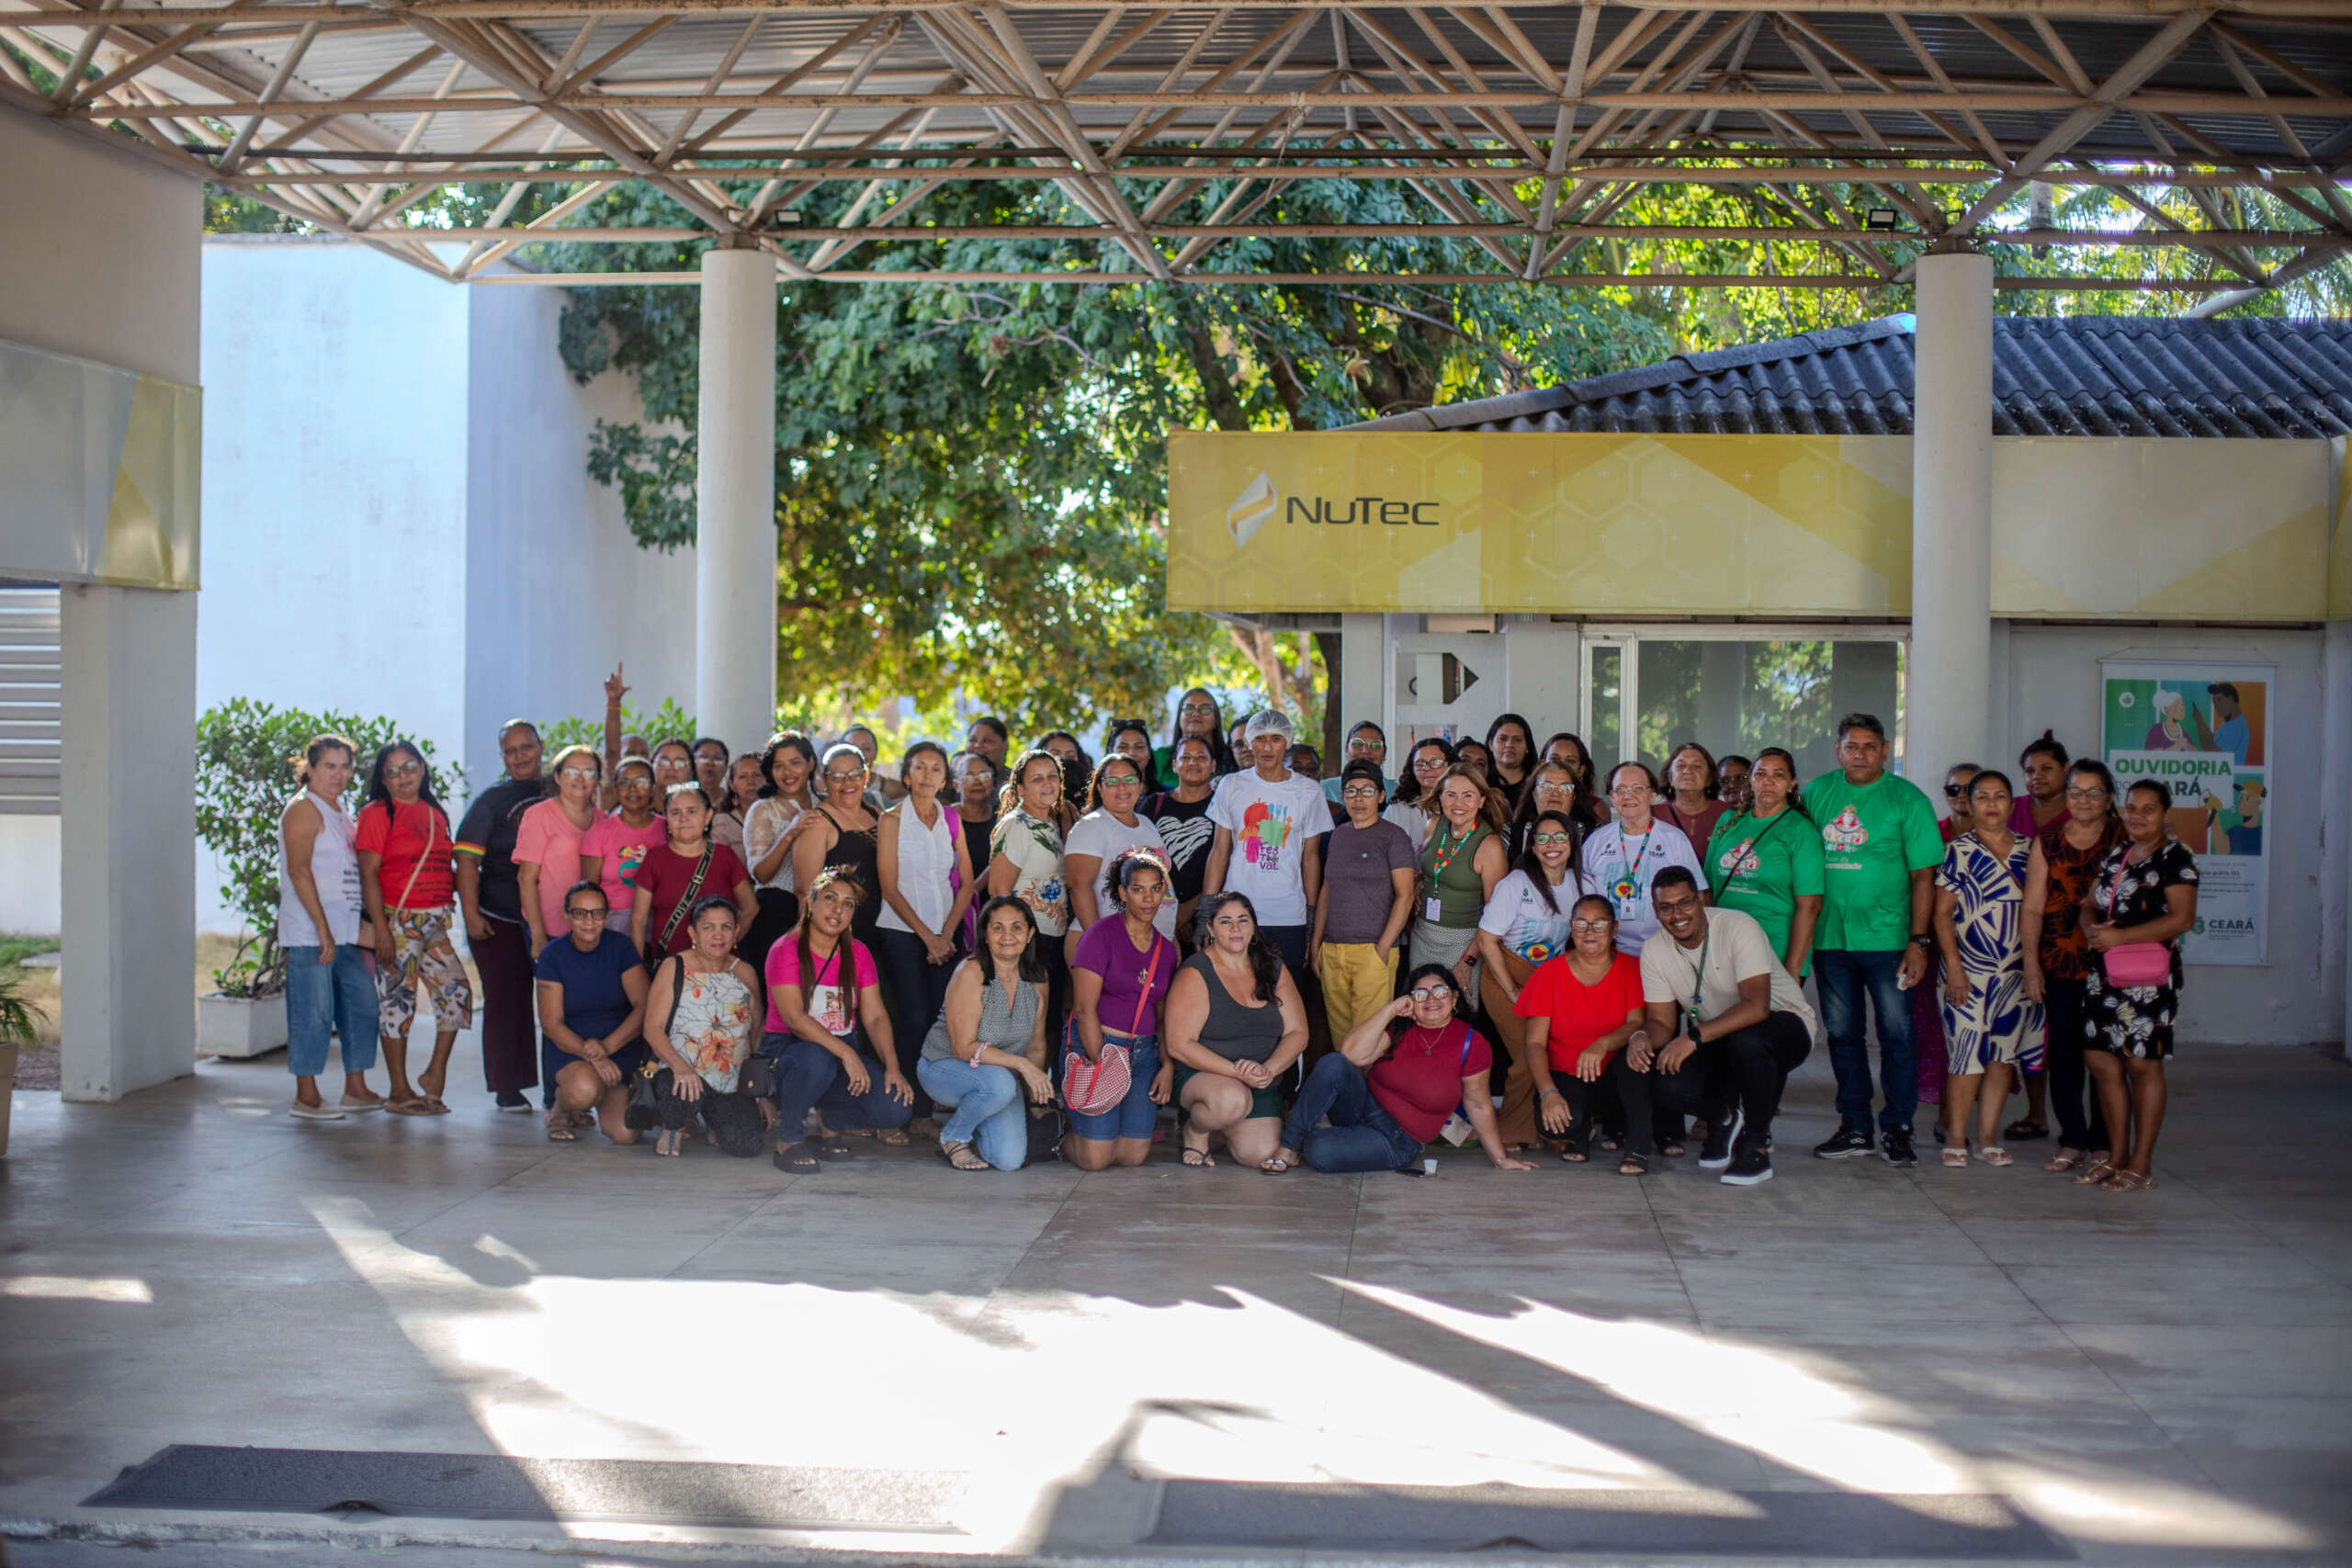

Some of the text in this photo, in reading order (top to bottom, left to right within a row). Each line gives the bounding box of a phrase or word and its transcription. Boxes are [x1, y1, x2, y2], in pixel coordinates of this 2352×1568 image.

[1287, 497, 1440, 525] NuTec
[2115, 759, 2232, 775] OUVIDORIA
[2163, 776, 2201, 796] ARÁ
[2209, 918, 2254, 930] CEARÁ
